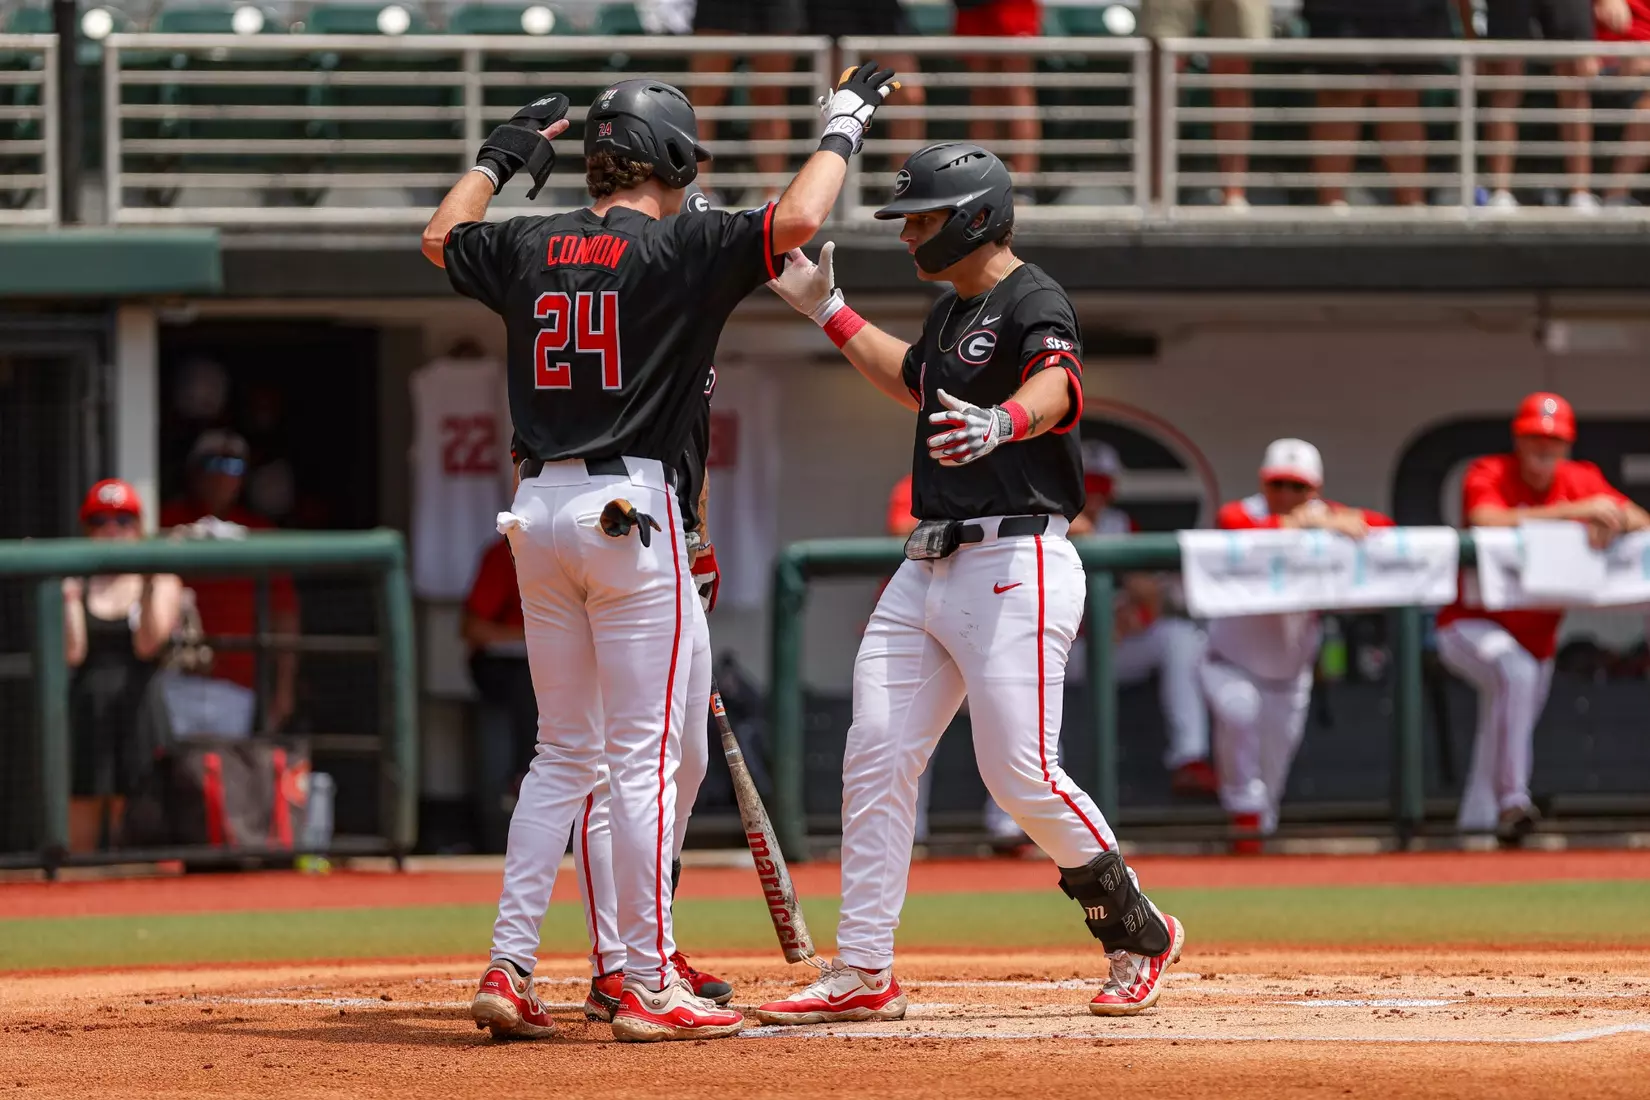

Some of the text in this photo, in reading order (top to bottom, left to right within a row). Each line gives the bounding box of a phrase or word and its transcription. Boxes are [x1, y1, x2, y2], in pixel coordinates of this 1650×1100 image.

[599, 121, 612, 137] 24
[533, 290, 623, 390] 24
[441, 416, 499, 475] 22
[747, 831, 807, 950] marucci
